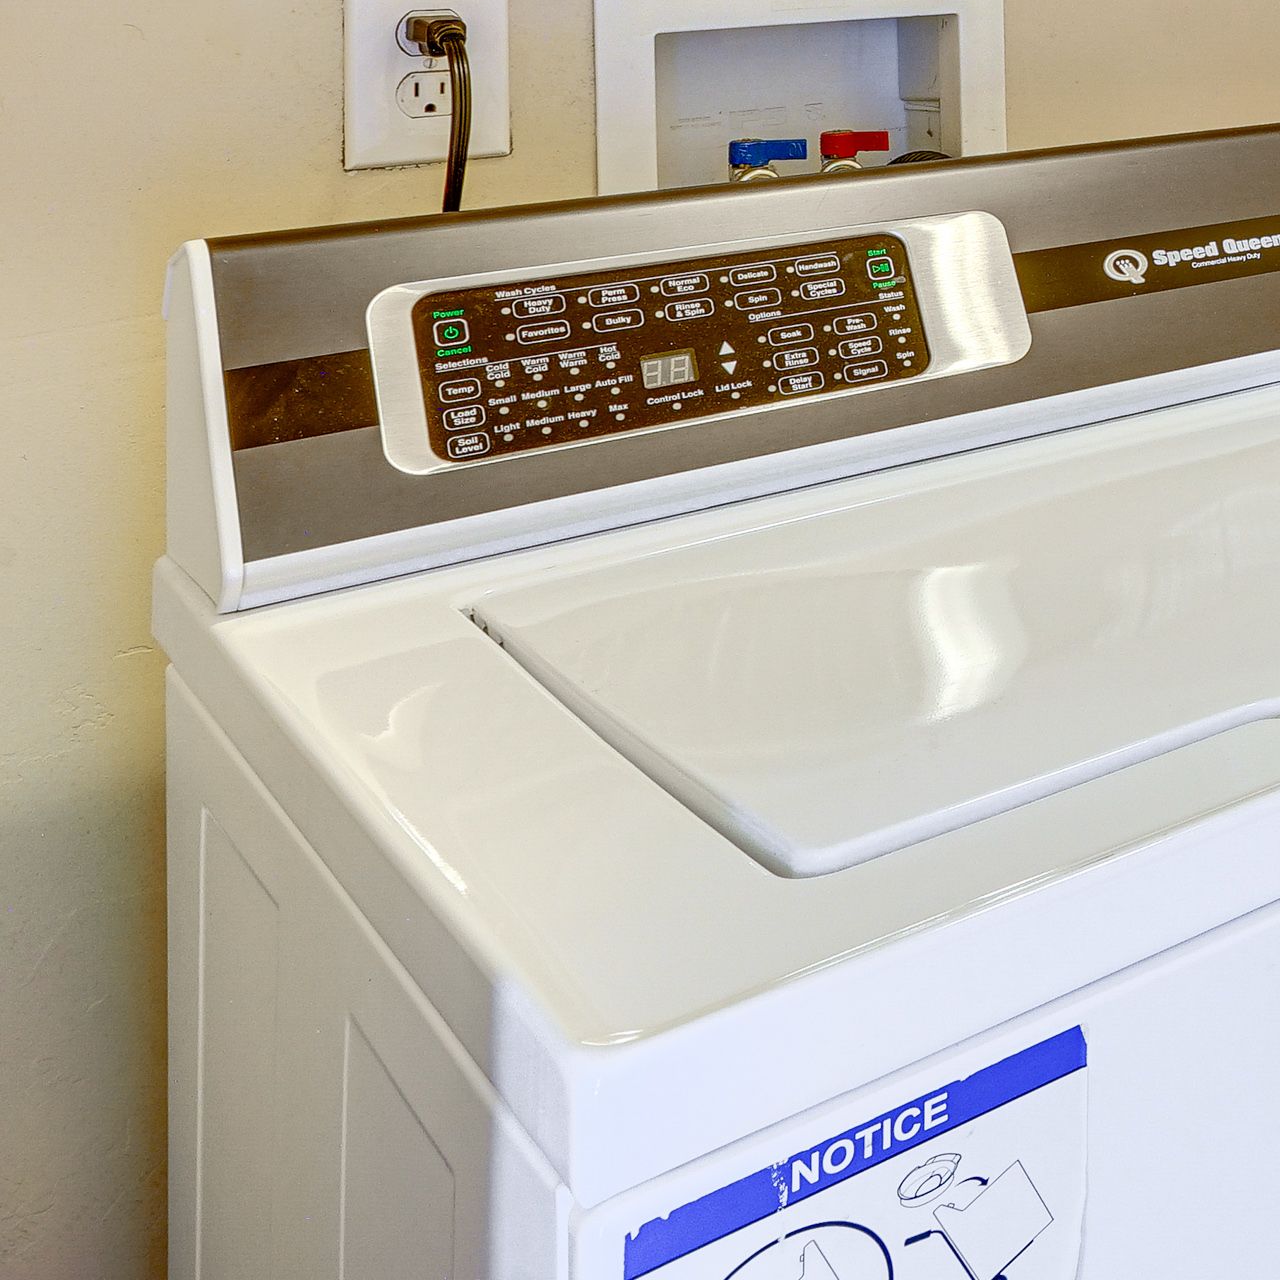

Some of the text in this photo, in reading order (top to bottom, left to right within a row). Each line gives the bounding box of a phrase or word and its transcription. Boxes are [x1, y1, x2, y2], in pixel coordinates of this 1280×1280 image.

[868, 249, 887, 257] Start
[1152, 242, 1219, 266] Speed
[1191, 252, 1261, 268] Commercial Heavy Duty
[798, 261, 837, 272] Handwash
[737, 270, 769, 280] Delicate
[668, 277, 700, 288] Normal
[807, 281, 837, 291] Special
[872, 280, 896, 289] Pause
[495, 285, 556, 299] Wash Cycles
[601, 288, 625, 297] Perm
[810, 288, 837, 297] Cycles
[878, 291, 903, 300] Status
[523, 298, 553, 308] Heavy
[601, 294, 628, 304] Press
[748, 295, 768, 304] Spin
[528, 305, 551, 314] Duty
[675, 302, 701, 311] Rinse
[884, 304, 906, 313] Wash
[433, 309, 464, 319] Power
[685, 308, 705, 317] Spin
[748, 310, 781, 322] Options
[605, 315, 632, 326] Bulky
[522, 326, 566, 338] Favorites
[846, 323, 866, 331] Wash
[889, 327, 911, 336] Rinse
[780, 330, 802, 339] Soak
[600, 345, 617, 353] Hot
[849, 340, 872, 350] Speed
[437, 346, 471, 357] Cancel
[558, 350, 586, 360] Warm
[851, 346, 872, 355] Cycle
[896, 351, 915, 360] Spin
[598, 352, 621, 362] Cold
[784, 352, 807, 360] Extra
[435, 357, 488, 371] Selections
[521, 357, 549, 367] Warm
[559, 358, 587, 368] Warm
[785, 358, 809, 367] Rinse
[486, 363, 509, 373] Cold
[525, 364, 548, 374] Cold
[853, 366, 879, 376] Signal
[487, 371, 511, 380] Cold
[595, 375, 633, 388] Auto Fill
[715, 379, 752, 392] Lid Lock
[789, 376, 812, 386] Delay
[445, 385, 475, 396] Temp
[564, 382, 592, 394] Large
[792, 382, 813, 391] Start
[521, 388, 560, 400] Medium
[647, 389, 704, 405] Control Lock
[488, 395, 517, 406] Small
[609, 403, 629, 412] Max
[451, 408, 477, 419] Load
[567, 409, 597, 420] Heavy
[454, 416, 476, 425] Size
[526, 415, 564, 427] Medium
[494, 422, 521, 433] Light
[458, 436, 478, 446] Soil
[455, 443, 483, 454] Level
[791, 1093, 949, 1193] NOTICE
